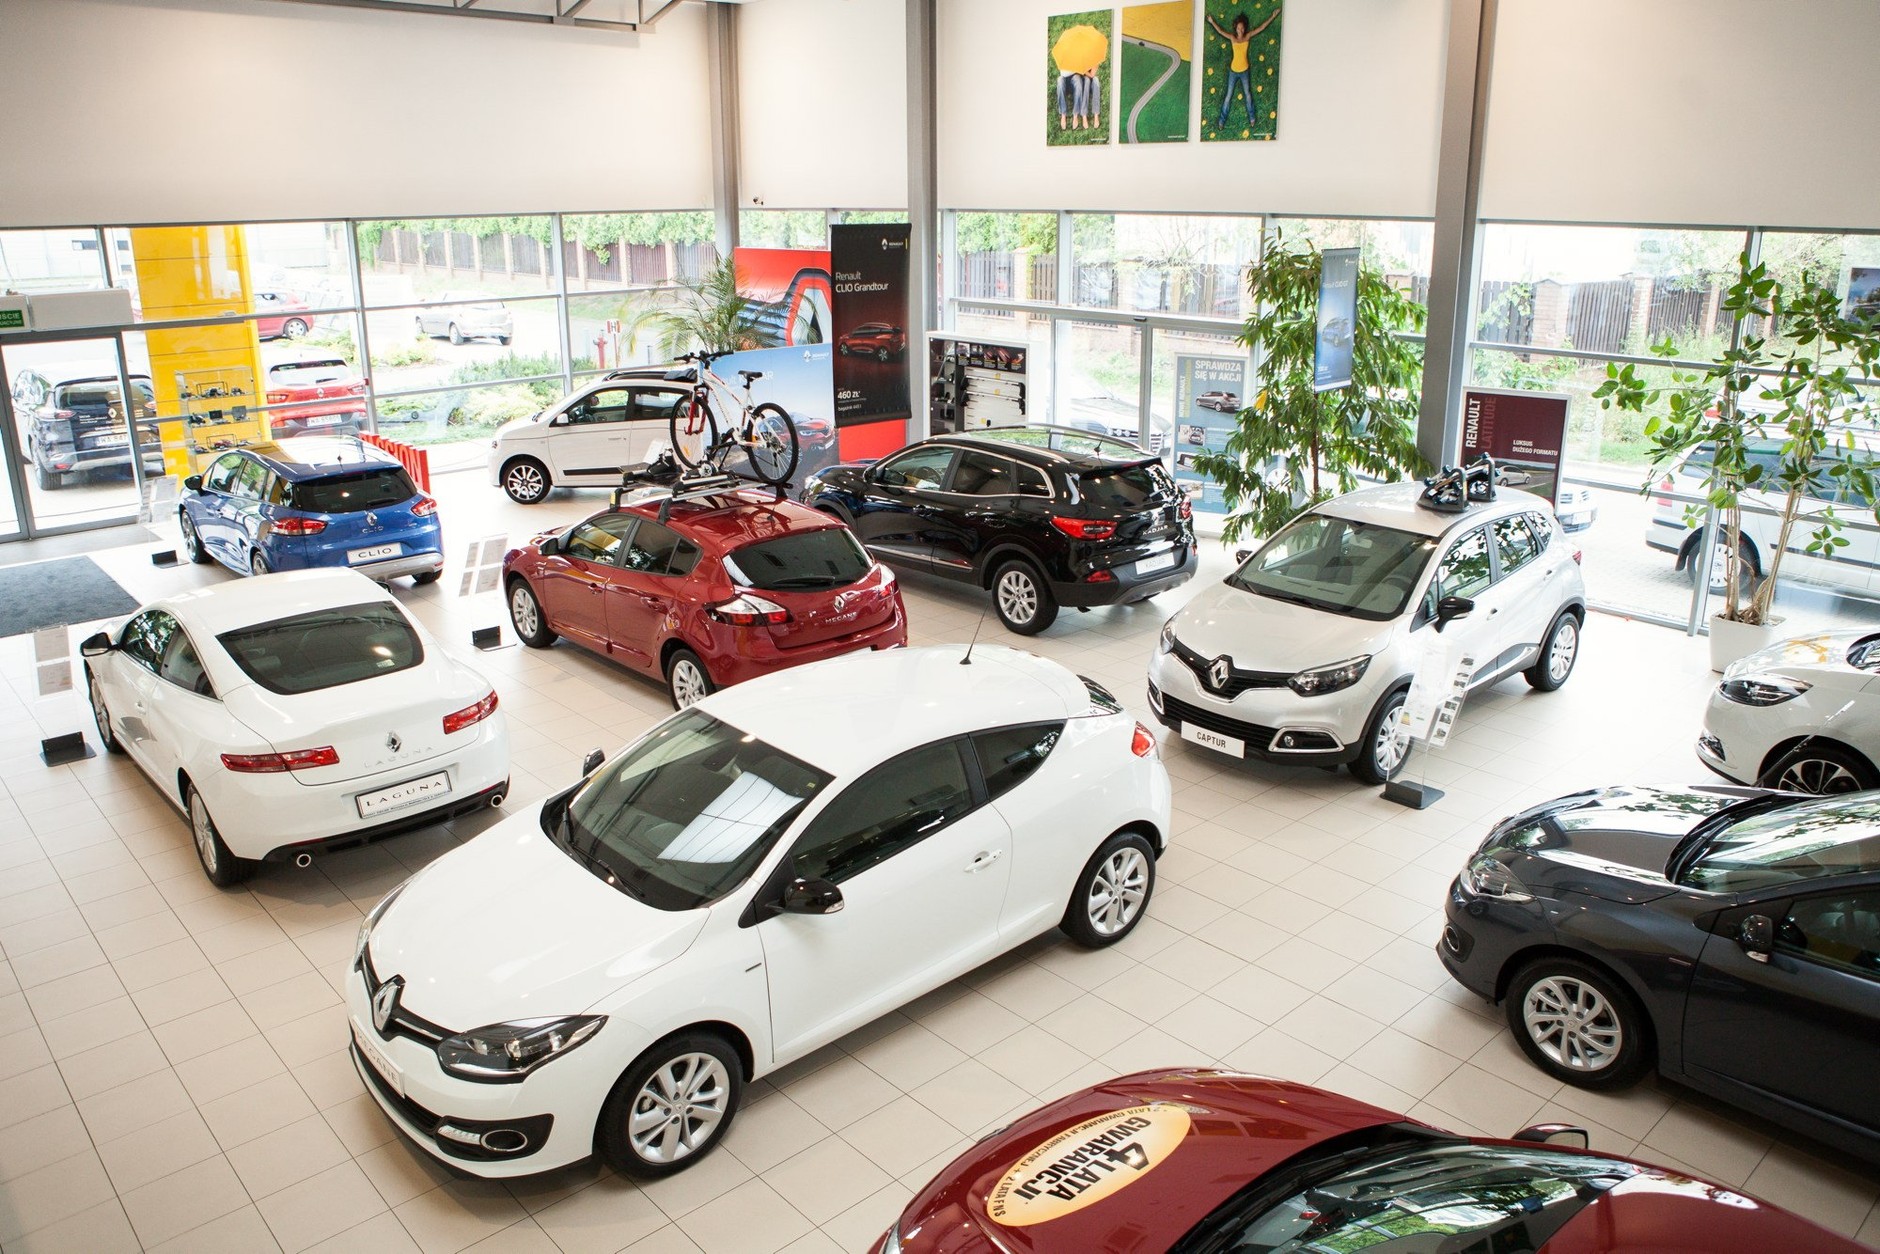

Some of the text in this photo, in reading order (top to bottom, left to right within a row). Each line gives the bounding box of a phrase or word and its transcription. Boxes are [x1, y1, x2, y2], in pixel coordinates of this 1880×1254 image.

[835, 271, 861, 281] Renault
[835, 282, 889, 293] CLIO Grandtour
[1195, 359, 1242, 372] SPRAWDZA
[1194, 370, 1242, 382] SIĘ W AKCJI
[837, 390, 852, 399] 460
[1465, 398, 1481, 448] RENAULT
[1481, 397, 1497, 449] LATITUDE
[1513, 439, 1533, 447] LUKSUS
[1533, 448, 1559, 456] FORMATU
[362, 525, 384, 534] CLIO
[1142, 524, 1169, 535] KADJAR
[358, 547, 392, 559] CLIO
[1196, 731, 1226, 748] CAPTUR
[364, 746, 433, 768] LAGUNA
[366, 781, 442, 807] LAGUNA
[1046, 1141, 1150, 1201] 4 LATA
